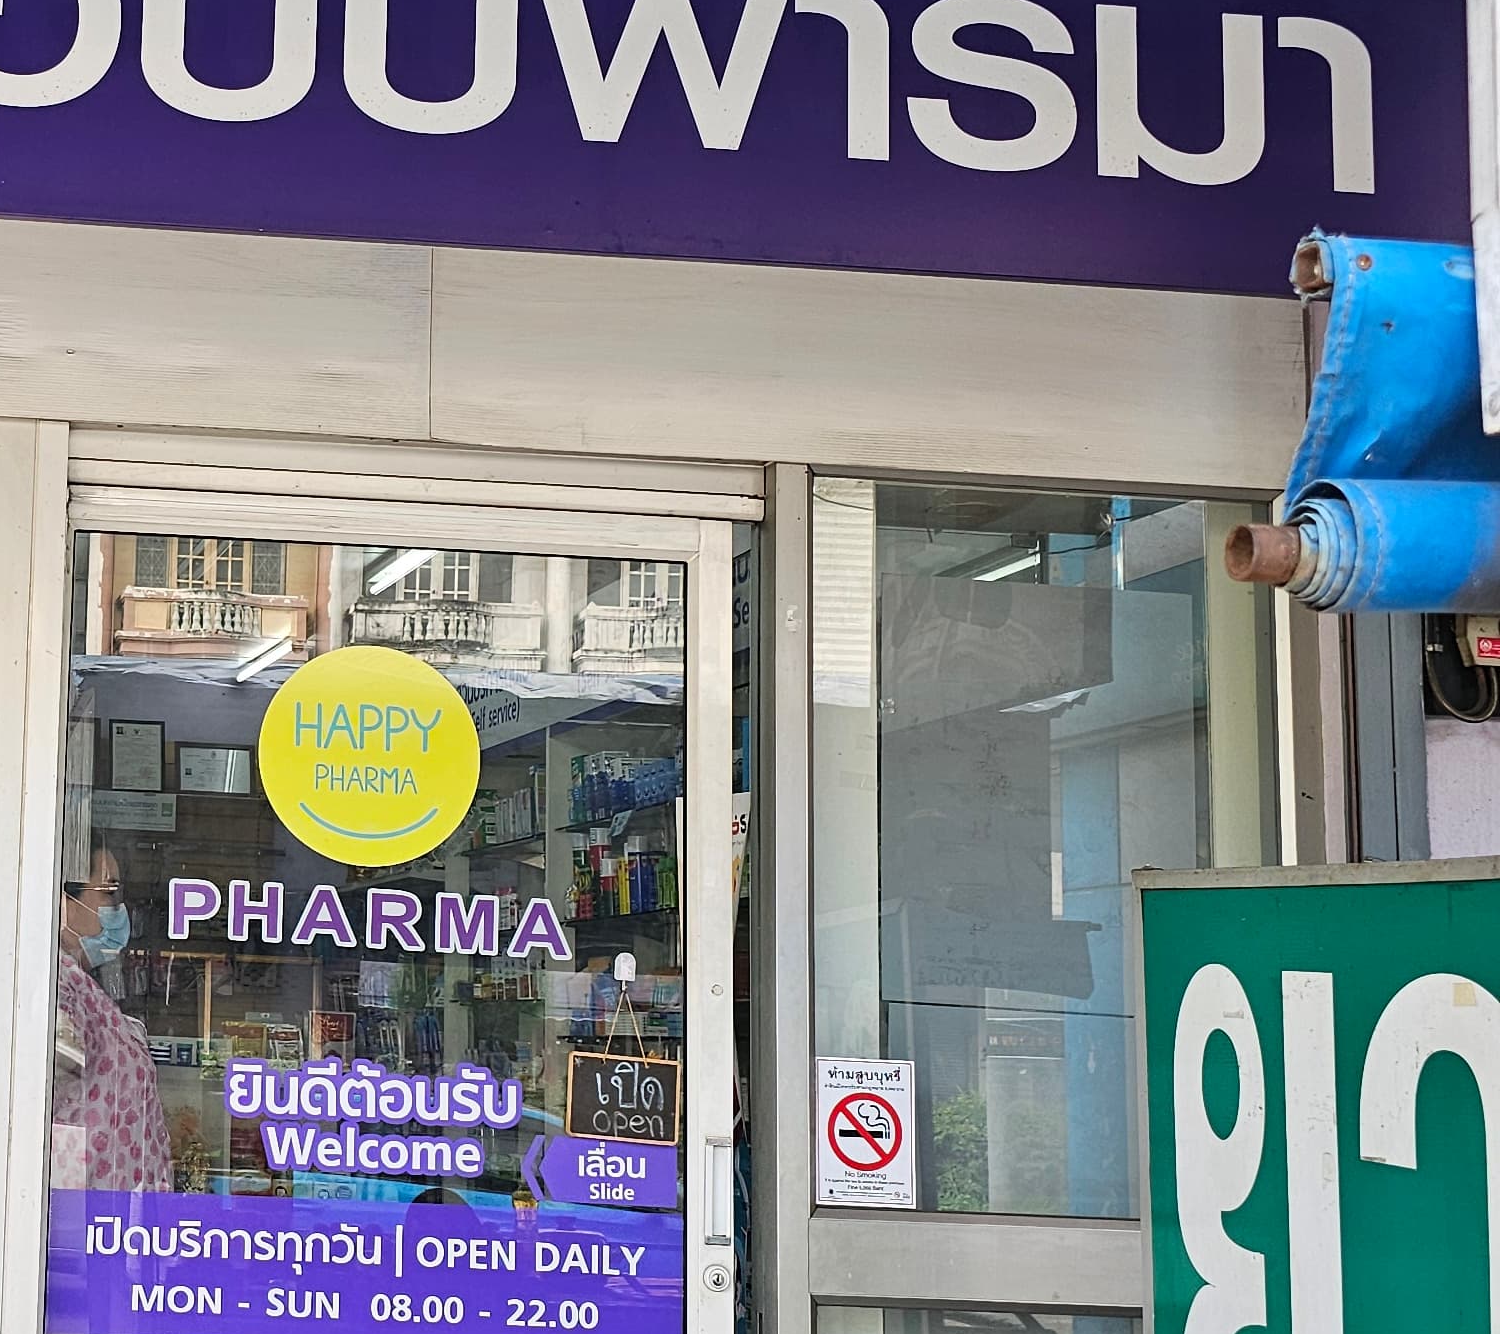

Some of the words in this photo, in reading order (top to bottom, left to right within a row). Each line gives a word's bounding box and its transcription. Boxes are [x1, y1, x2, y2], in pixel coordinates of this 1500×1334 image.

[293, 701, 443, 753] HAPPY
[314, 763, 418, 796] PHARMA
[166, 874, 575, 961] PHARMA
[228, 1063, 518, 1126] ยินดีต้อนรับ
[595, 1061, 665, 1111] เปิด
[267, 1128, 482, 1175] Welcome
[577, 1142, 647, 1180] เลื่อน
[589, 1182, 636, 1201] Slide
[85, 1217, 383, 1277] เปิดบริการทุกวัน
[416, 1236, 518, 1272] OPEN
[535, 1242, 647, 1277] DAILY
[131, 1284, 223, 1316] MON
[266, 1288, 341, 1320] SUN
[369, 1292, 465, 1325] 08.00
[506, 1298, 600, 1330] 22.00
